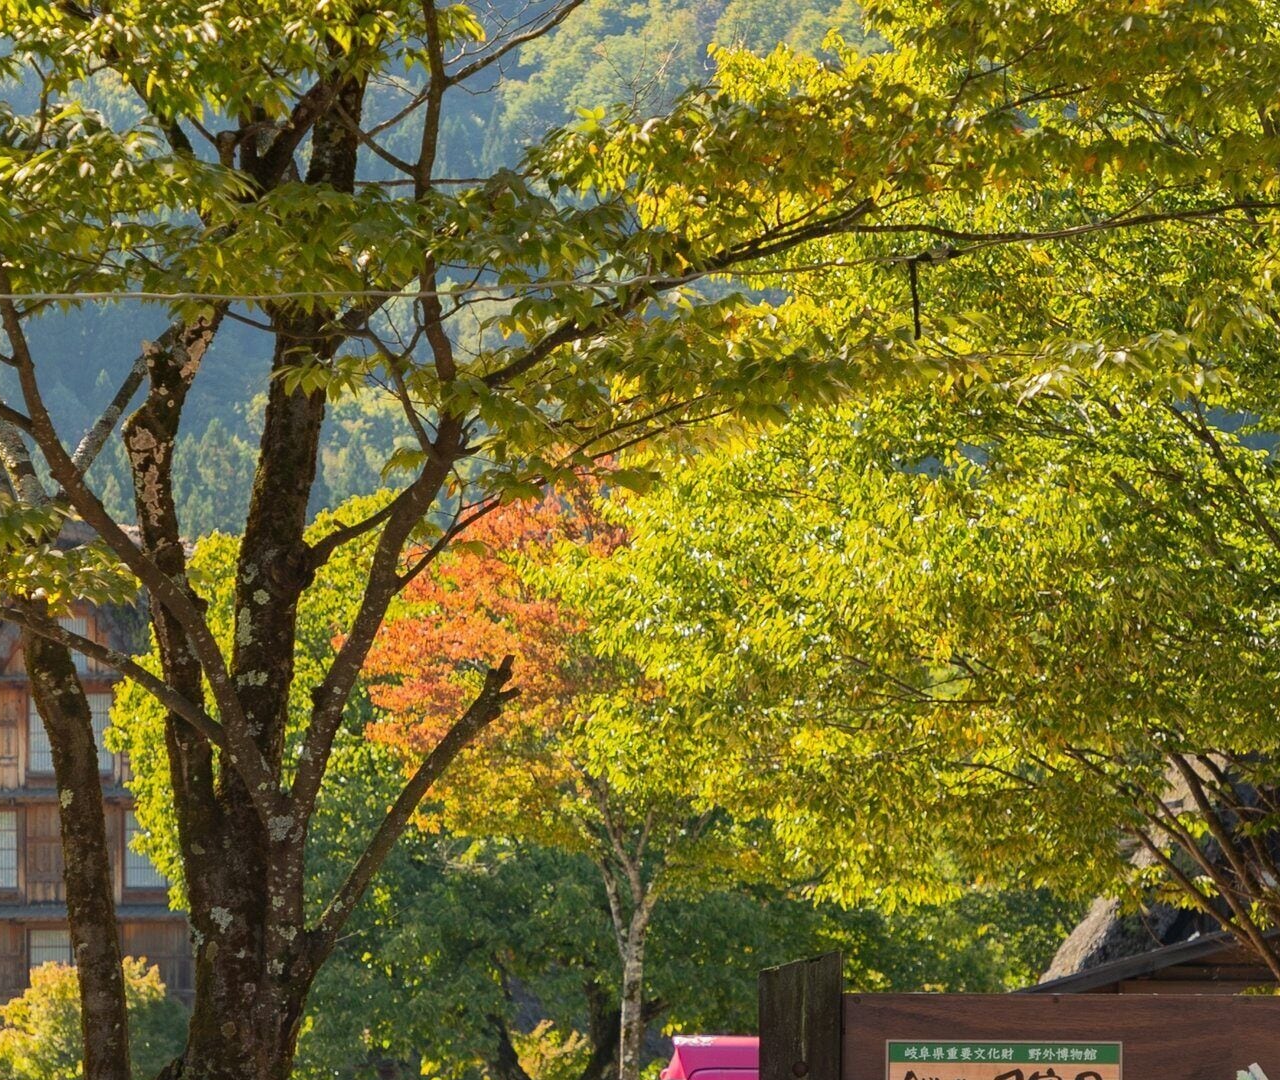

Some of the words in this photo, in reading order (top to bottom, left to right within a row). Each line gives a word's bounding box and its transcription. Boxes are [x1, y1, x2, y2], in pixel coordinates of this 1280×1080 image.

[904, 1047, 1014, 1060] 岐阜県重要文化財
[1028, 1047, 1097, 1061] 野外博物館
